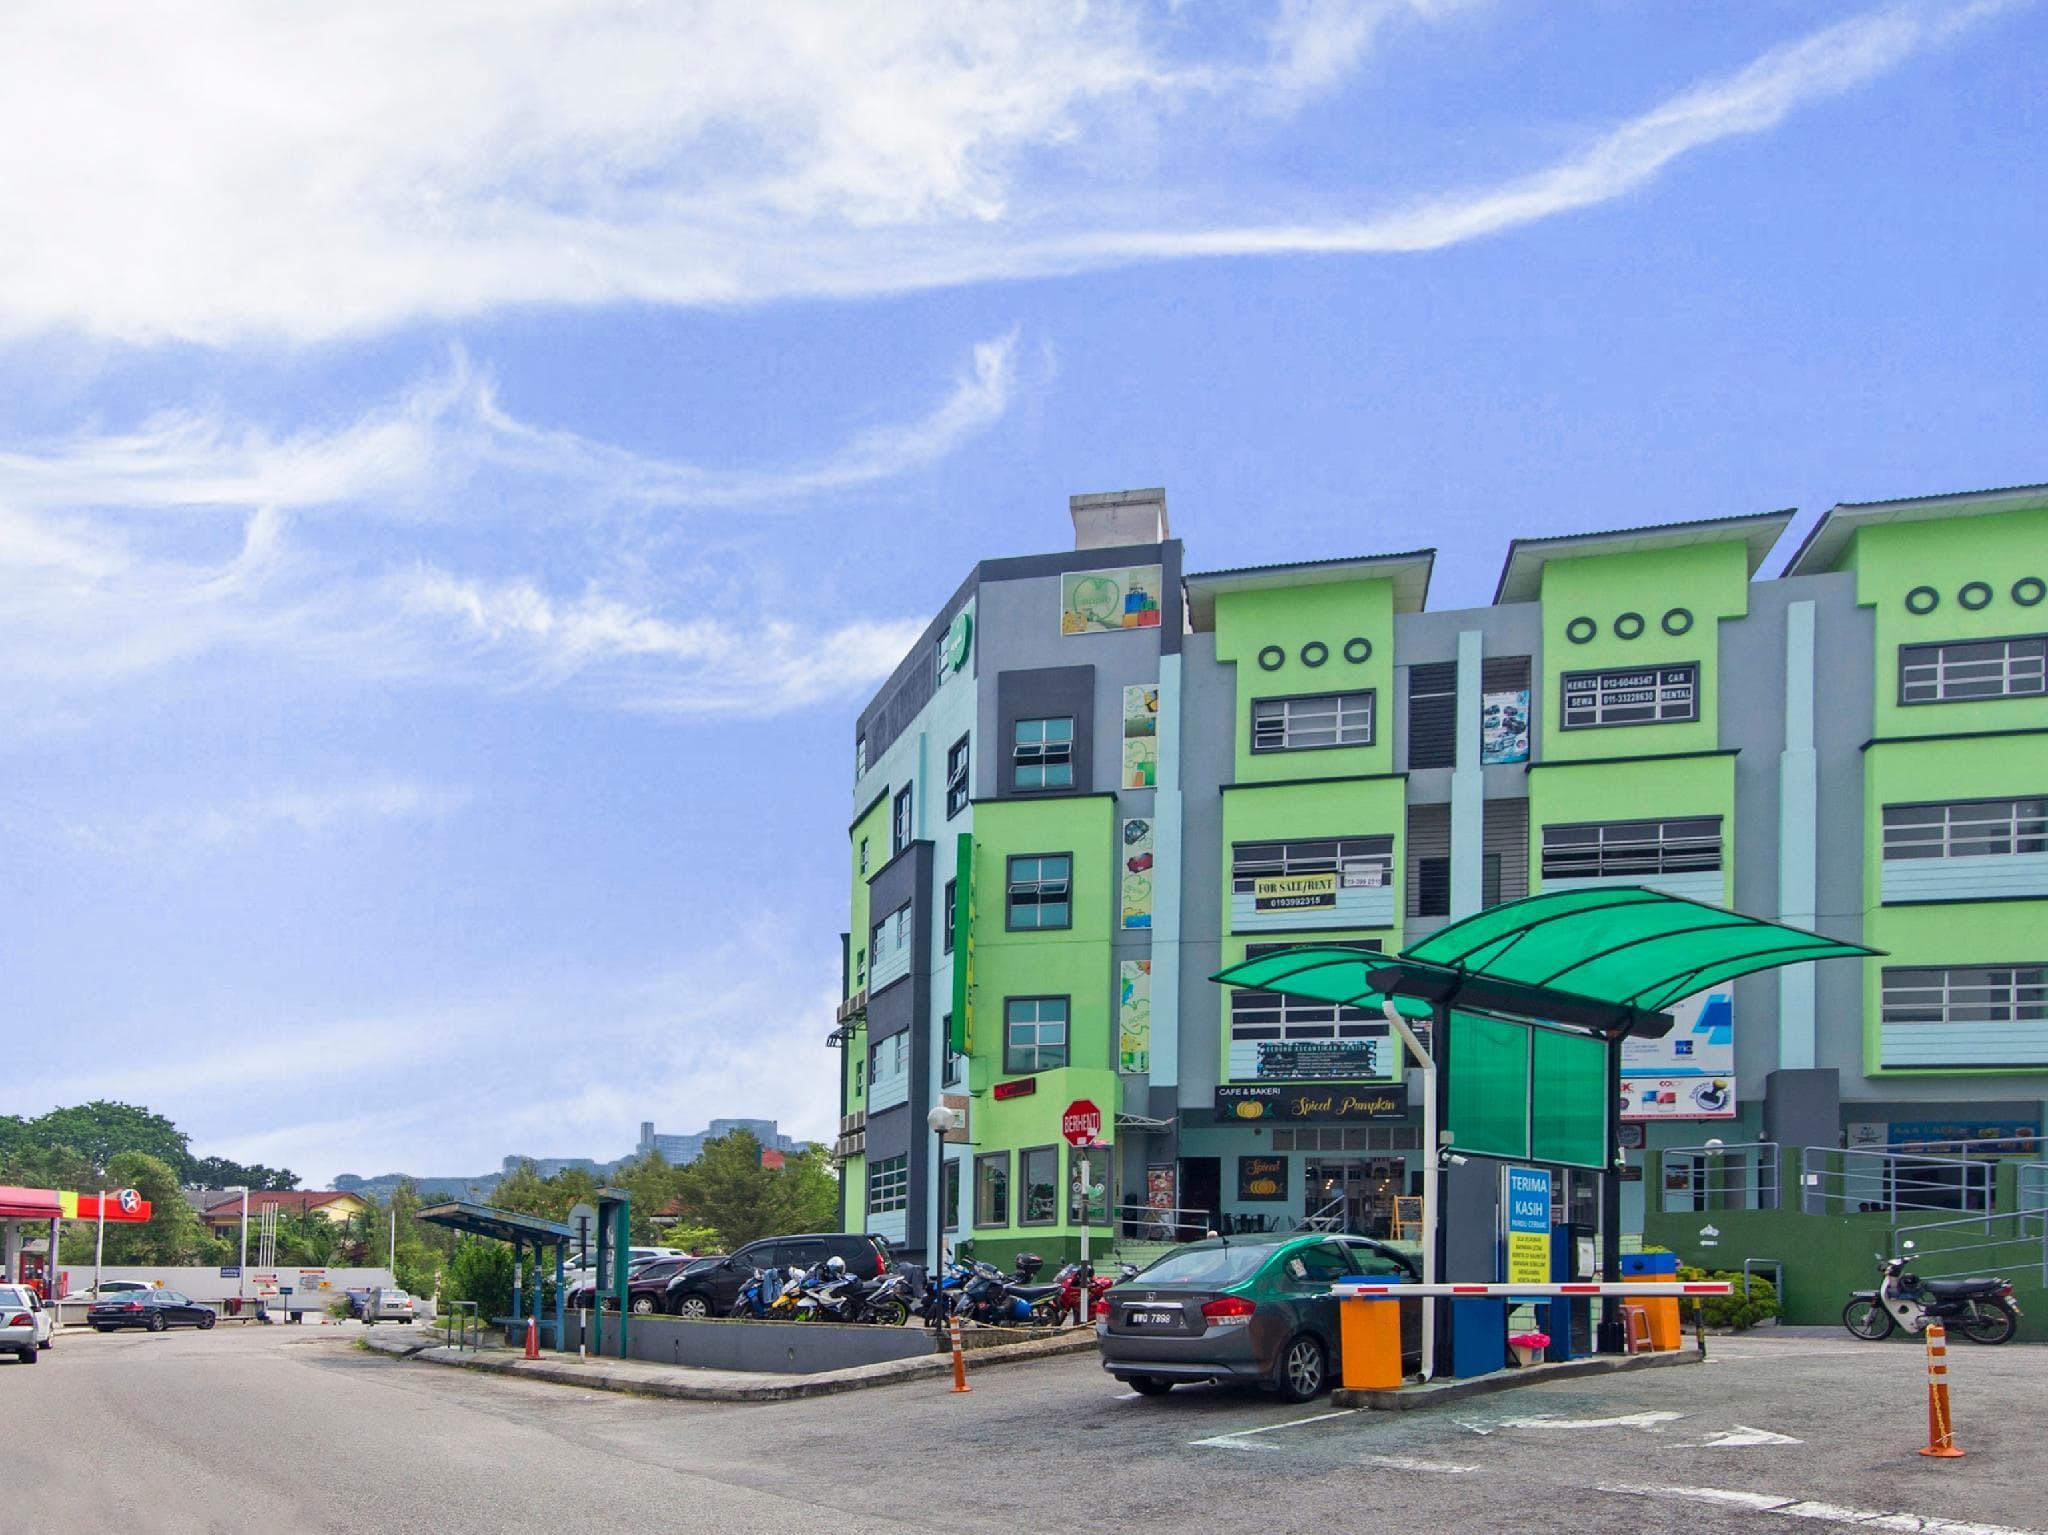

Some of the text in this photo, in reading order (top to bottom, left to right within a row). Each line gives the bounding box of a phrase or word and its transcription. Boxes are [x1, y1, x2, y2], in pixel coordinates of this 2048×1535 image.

[1567, 679, 1597, 690] KERETA
[1667, 673, 1685, 683] CAR
[1571, 697, 1593, 706] SEWA
[1662, 689, 1691, 699] RENTAL
[1258, 879, 1332, 894] FOR SALE/RENT
[1270, 896, 1321, 907] 0193992315
[1218, 1087, 1281, 1096] CAFE & BAKERI
[1292, 1096, 1395, 1116] Spiced Pumpkin
[1247, 1159, 1281, 1176] Spiced
[1512, 1176, 1547, 1192] TERIMA
[1515, 1200, 1543, 1217] KASIH
